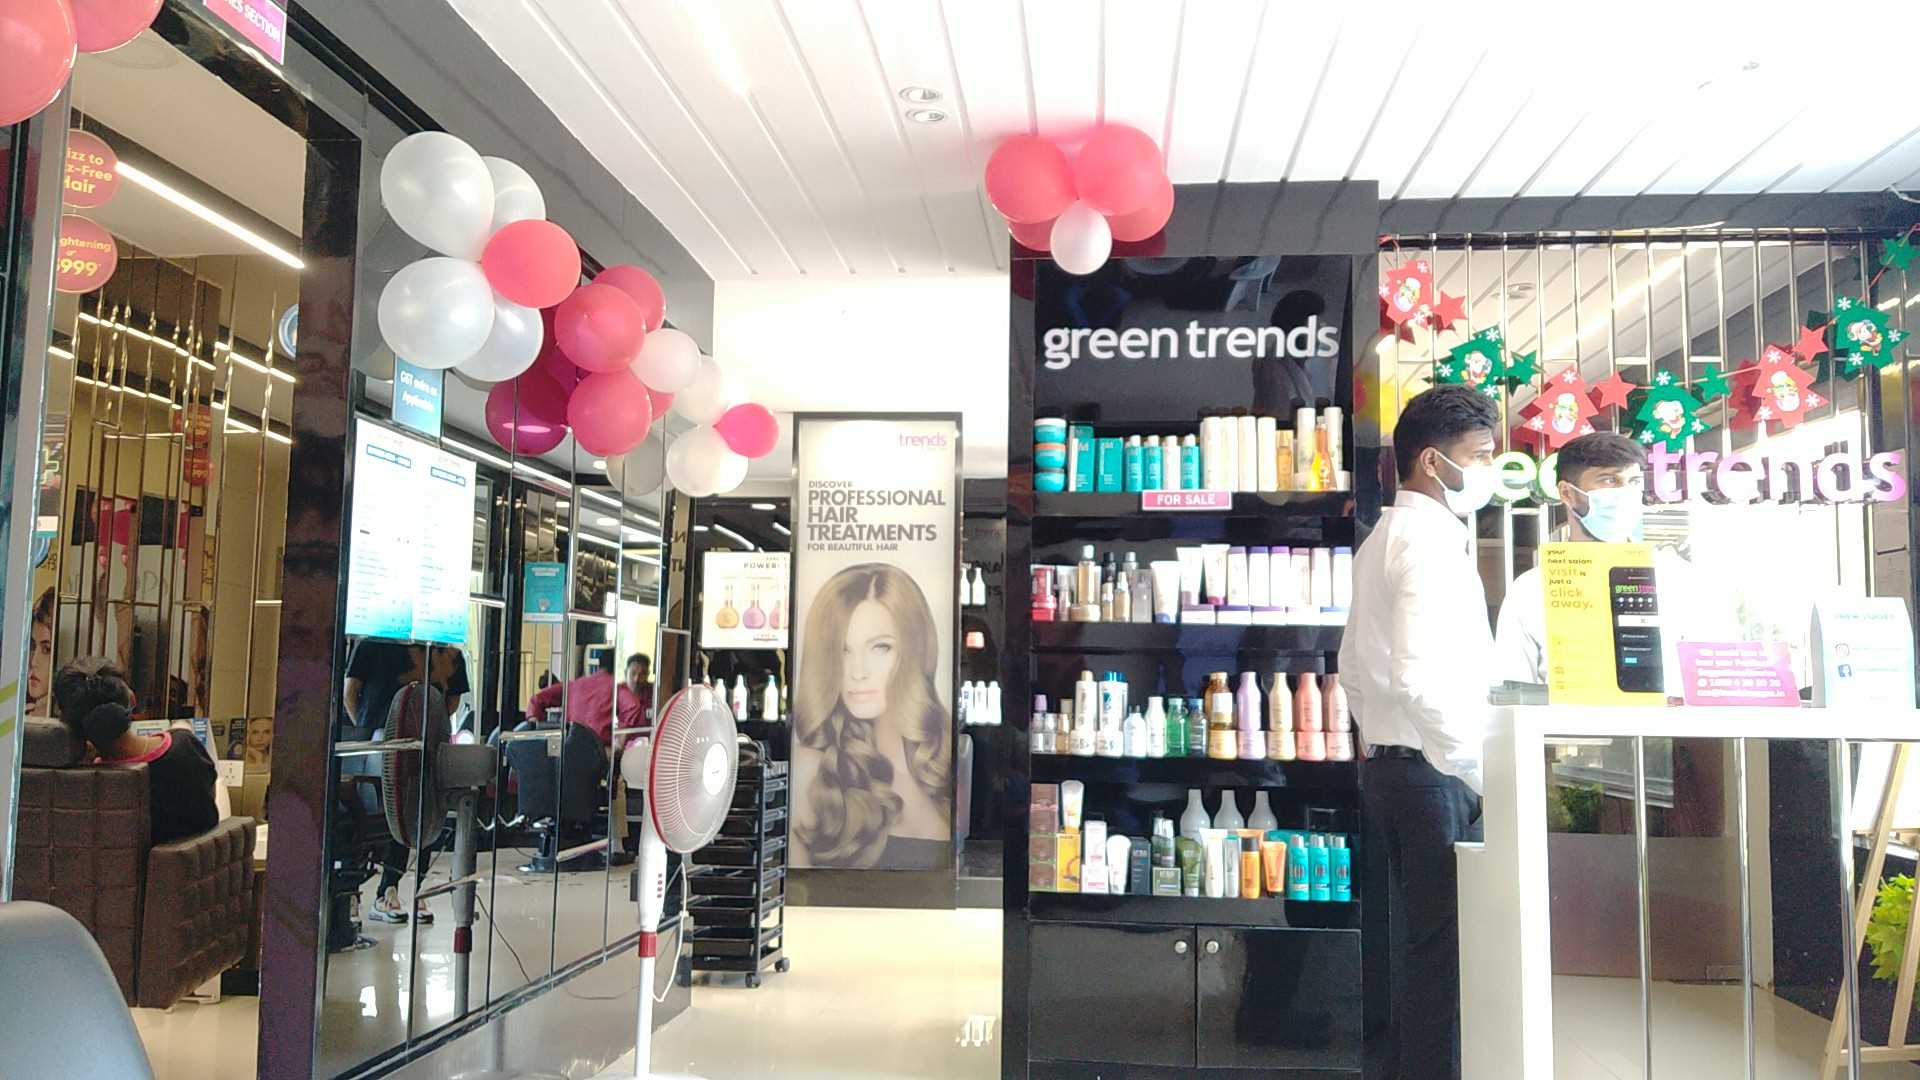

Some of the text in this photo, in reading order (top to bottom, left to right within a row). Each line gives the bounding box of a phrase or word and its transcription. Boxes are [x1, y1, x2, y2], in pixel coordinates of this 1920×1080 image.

[244, 4, 281, 42] SECTION
[66, 147, 104, 166] izz to
[65, 163, 113, 182] z-Free
[60, 236, 112, 253] ghtening
[57, 257, 98, 276] 999
[1043, 315, 1339, 370] green trends
[899, 432, 947, 447] trends
[1648, 437, 1905, 501] trends
[808, 489, 946, 506] PROFESSIONAL
[1157, 493, 1216, 506] FOR SALE
[808, 506, 858, 523] HAIR
[807, 523, 937, 542] TREATMENTS
[807, 543, 898, 552] FOR BEAUTIFUL HAIR
[1550, 587, 1583, 599] click
[1615, 584, 1639, 594] green
[1551, 599, 1594, 610] away.
